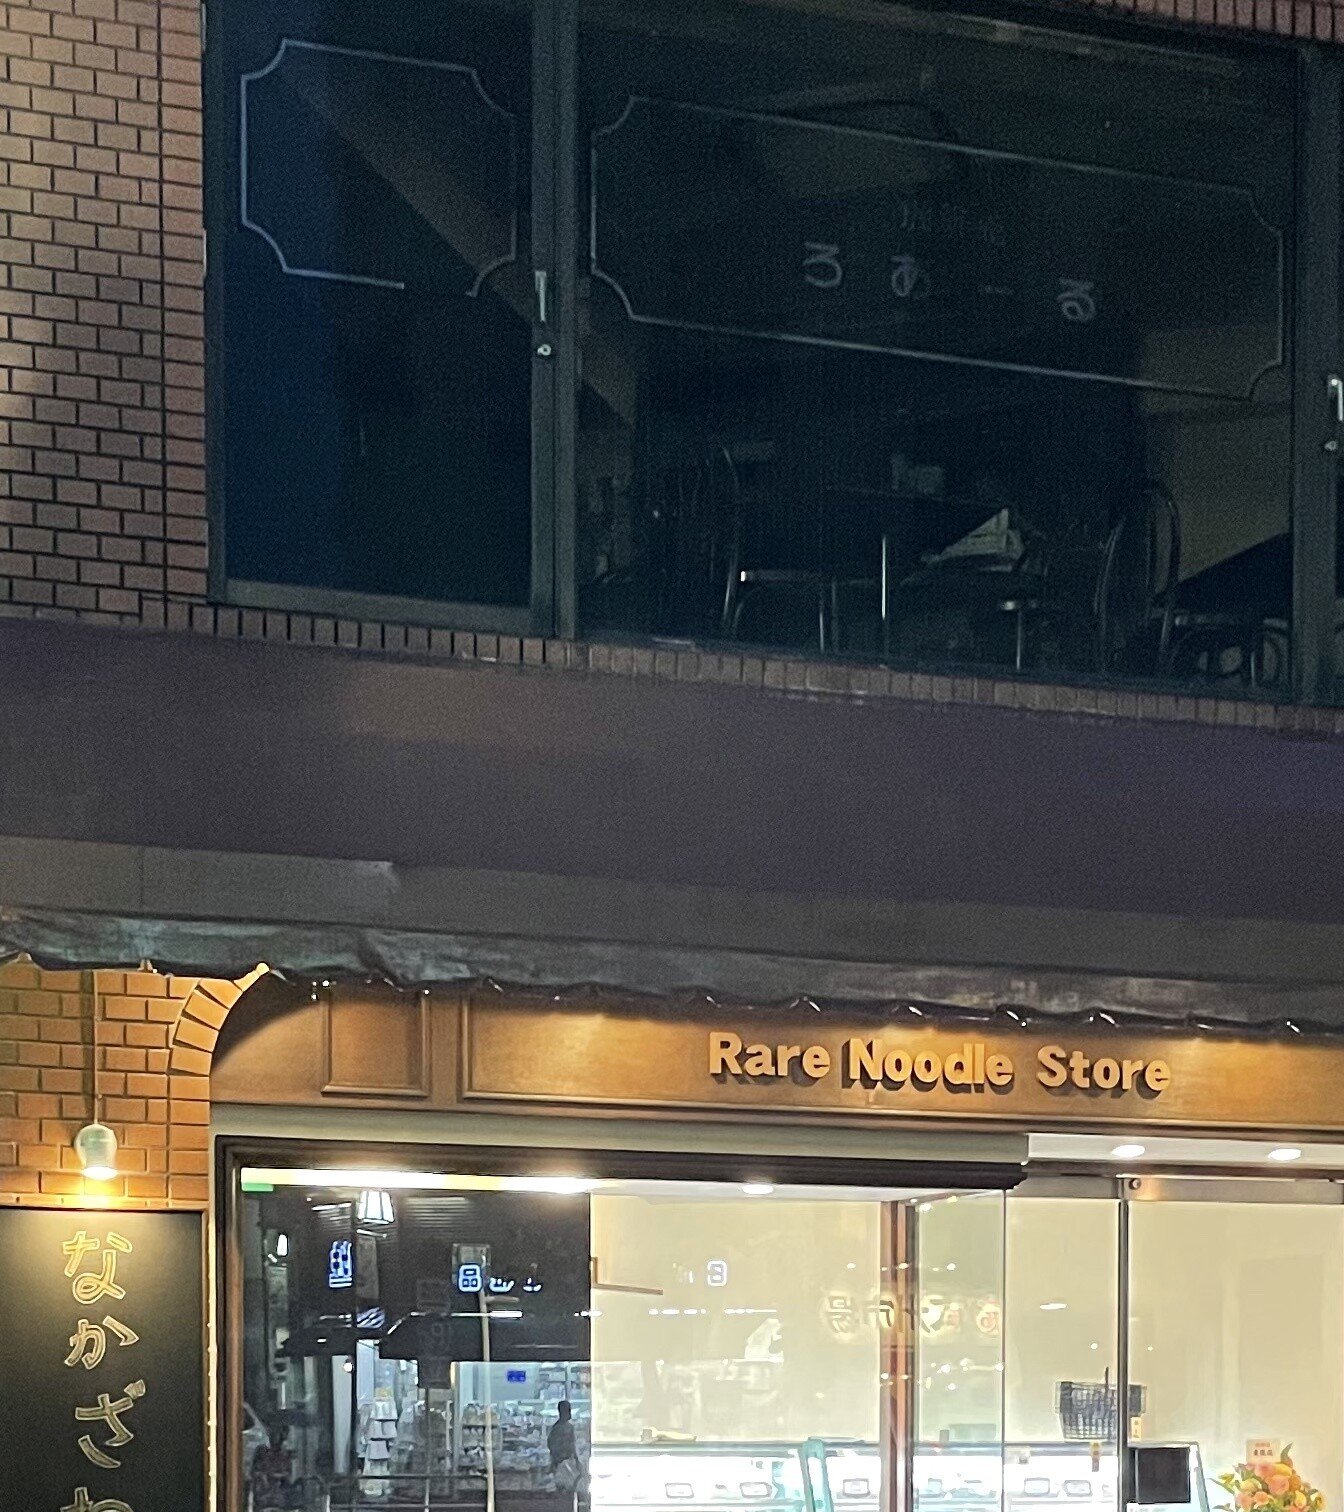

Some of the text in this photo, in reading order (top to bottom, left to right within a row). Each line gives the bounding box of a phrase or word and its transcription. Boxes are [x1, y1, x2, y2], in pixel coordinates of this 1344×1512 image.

[708, 1031, 1172, 1092] Rare Noodle Store
